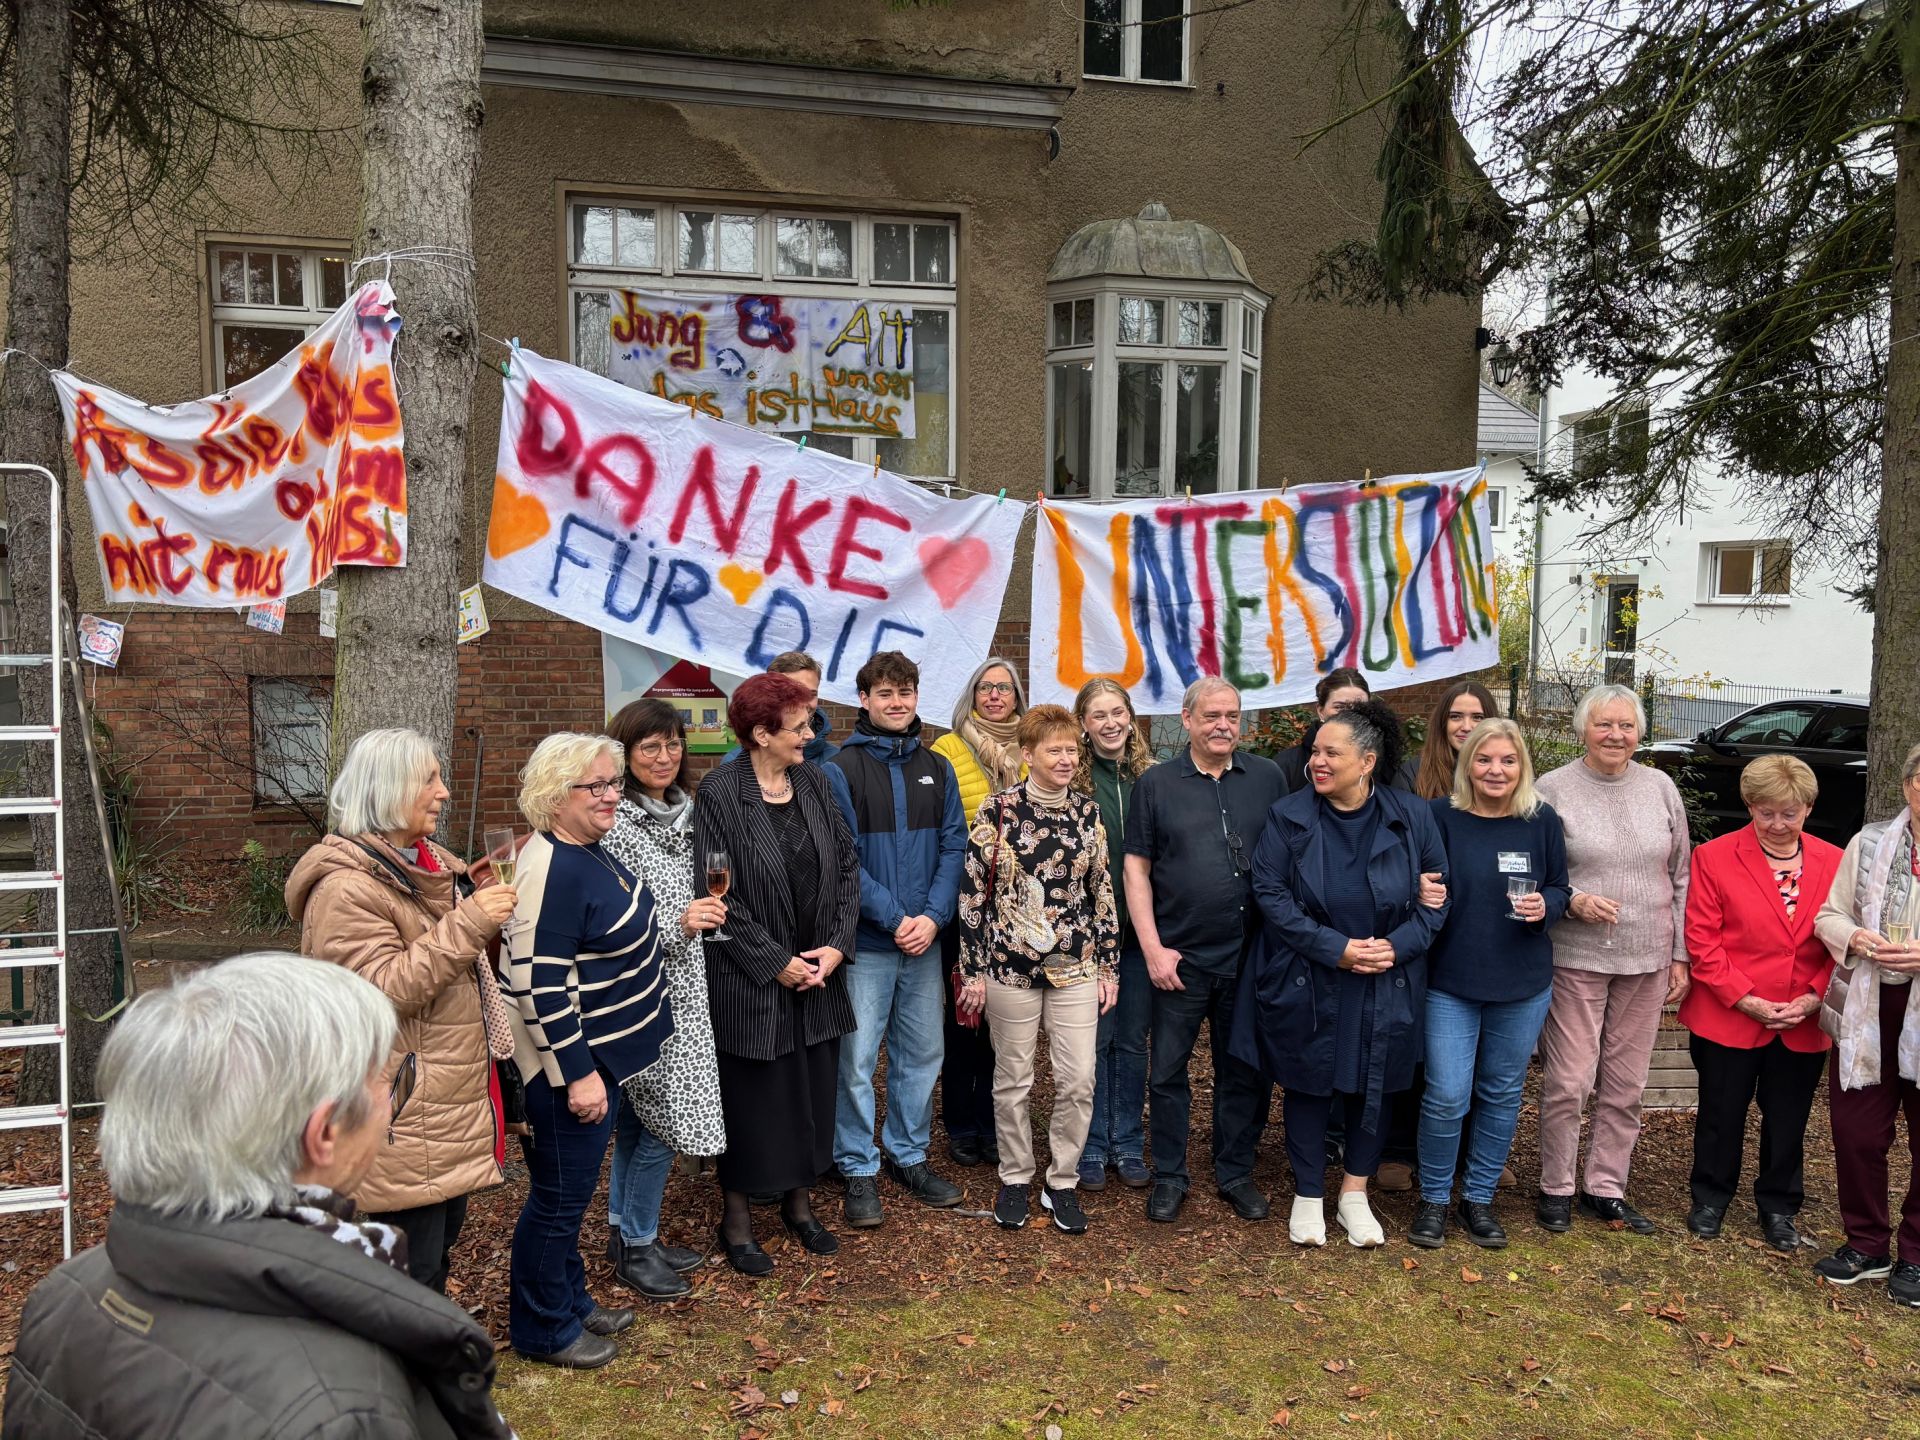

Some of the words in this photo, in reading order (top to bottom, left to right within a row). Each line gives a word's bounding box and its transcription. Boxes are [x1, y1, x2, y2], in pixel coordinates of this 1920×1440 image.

[746, 371, 809, 425] ist
[811, 385, 903, 431] Haus
[822, 363, 914, 401] unser
[516, 377, 912, 601] DANKE
[101, 500, 196, 595] mit
[204, 540, 288, 597] raus
[549, 512, 711, 651] FÜR
